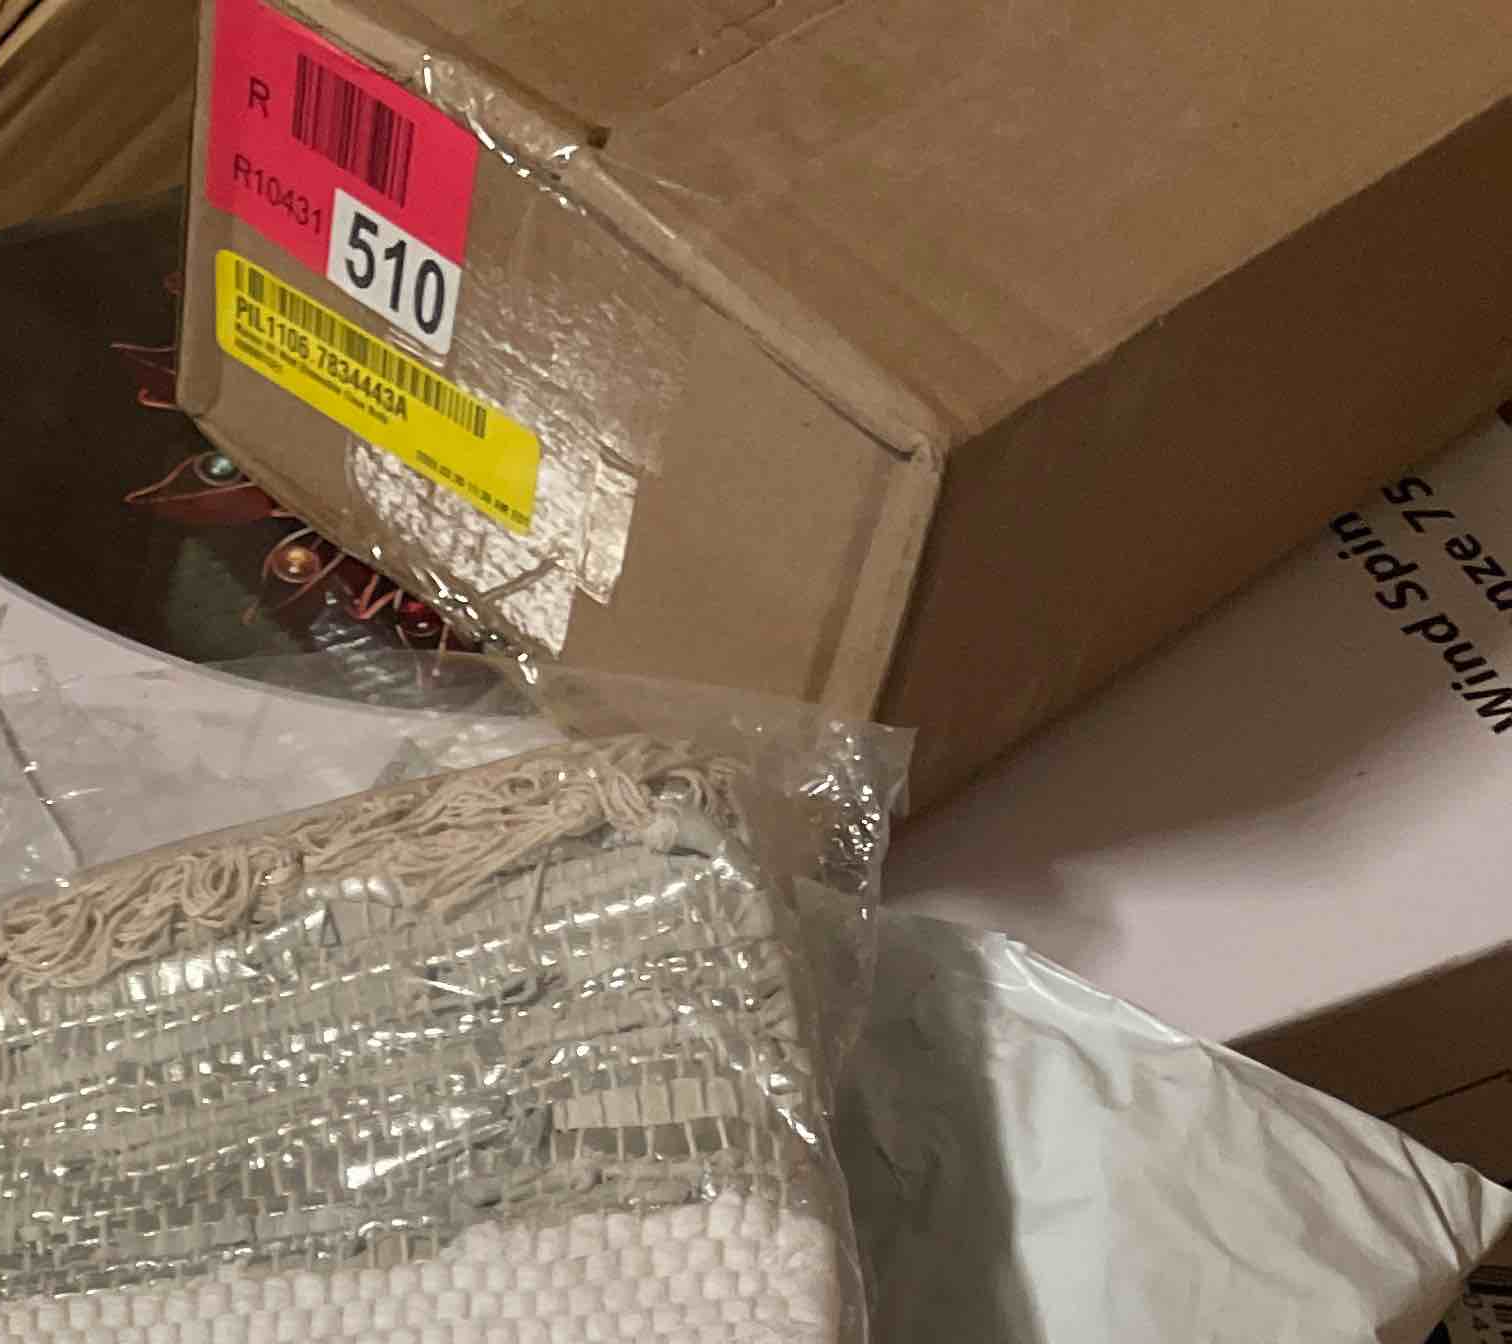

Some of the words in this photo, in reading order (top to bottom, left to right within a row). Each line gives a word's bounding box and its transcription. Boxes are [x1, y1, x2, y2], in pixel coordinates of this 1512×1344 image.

[248, 77, 271, 118] R
[232, 153, 321, 234] R10431
[345, 211, 447, 336] 510
[1381, 476, 1455, 534] 75
[1330, 511, 1429, 611] Spin
[1401, 613, 1512, 734] Wind
